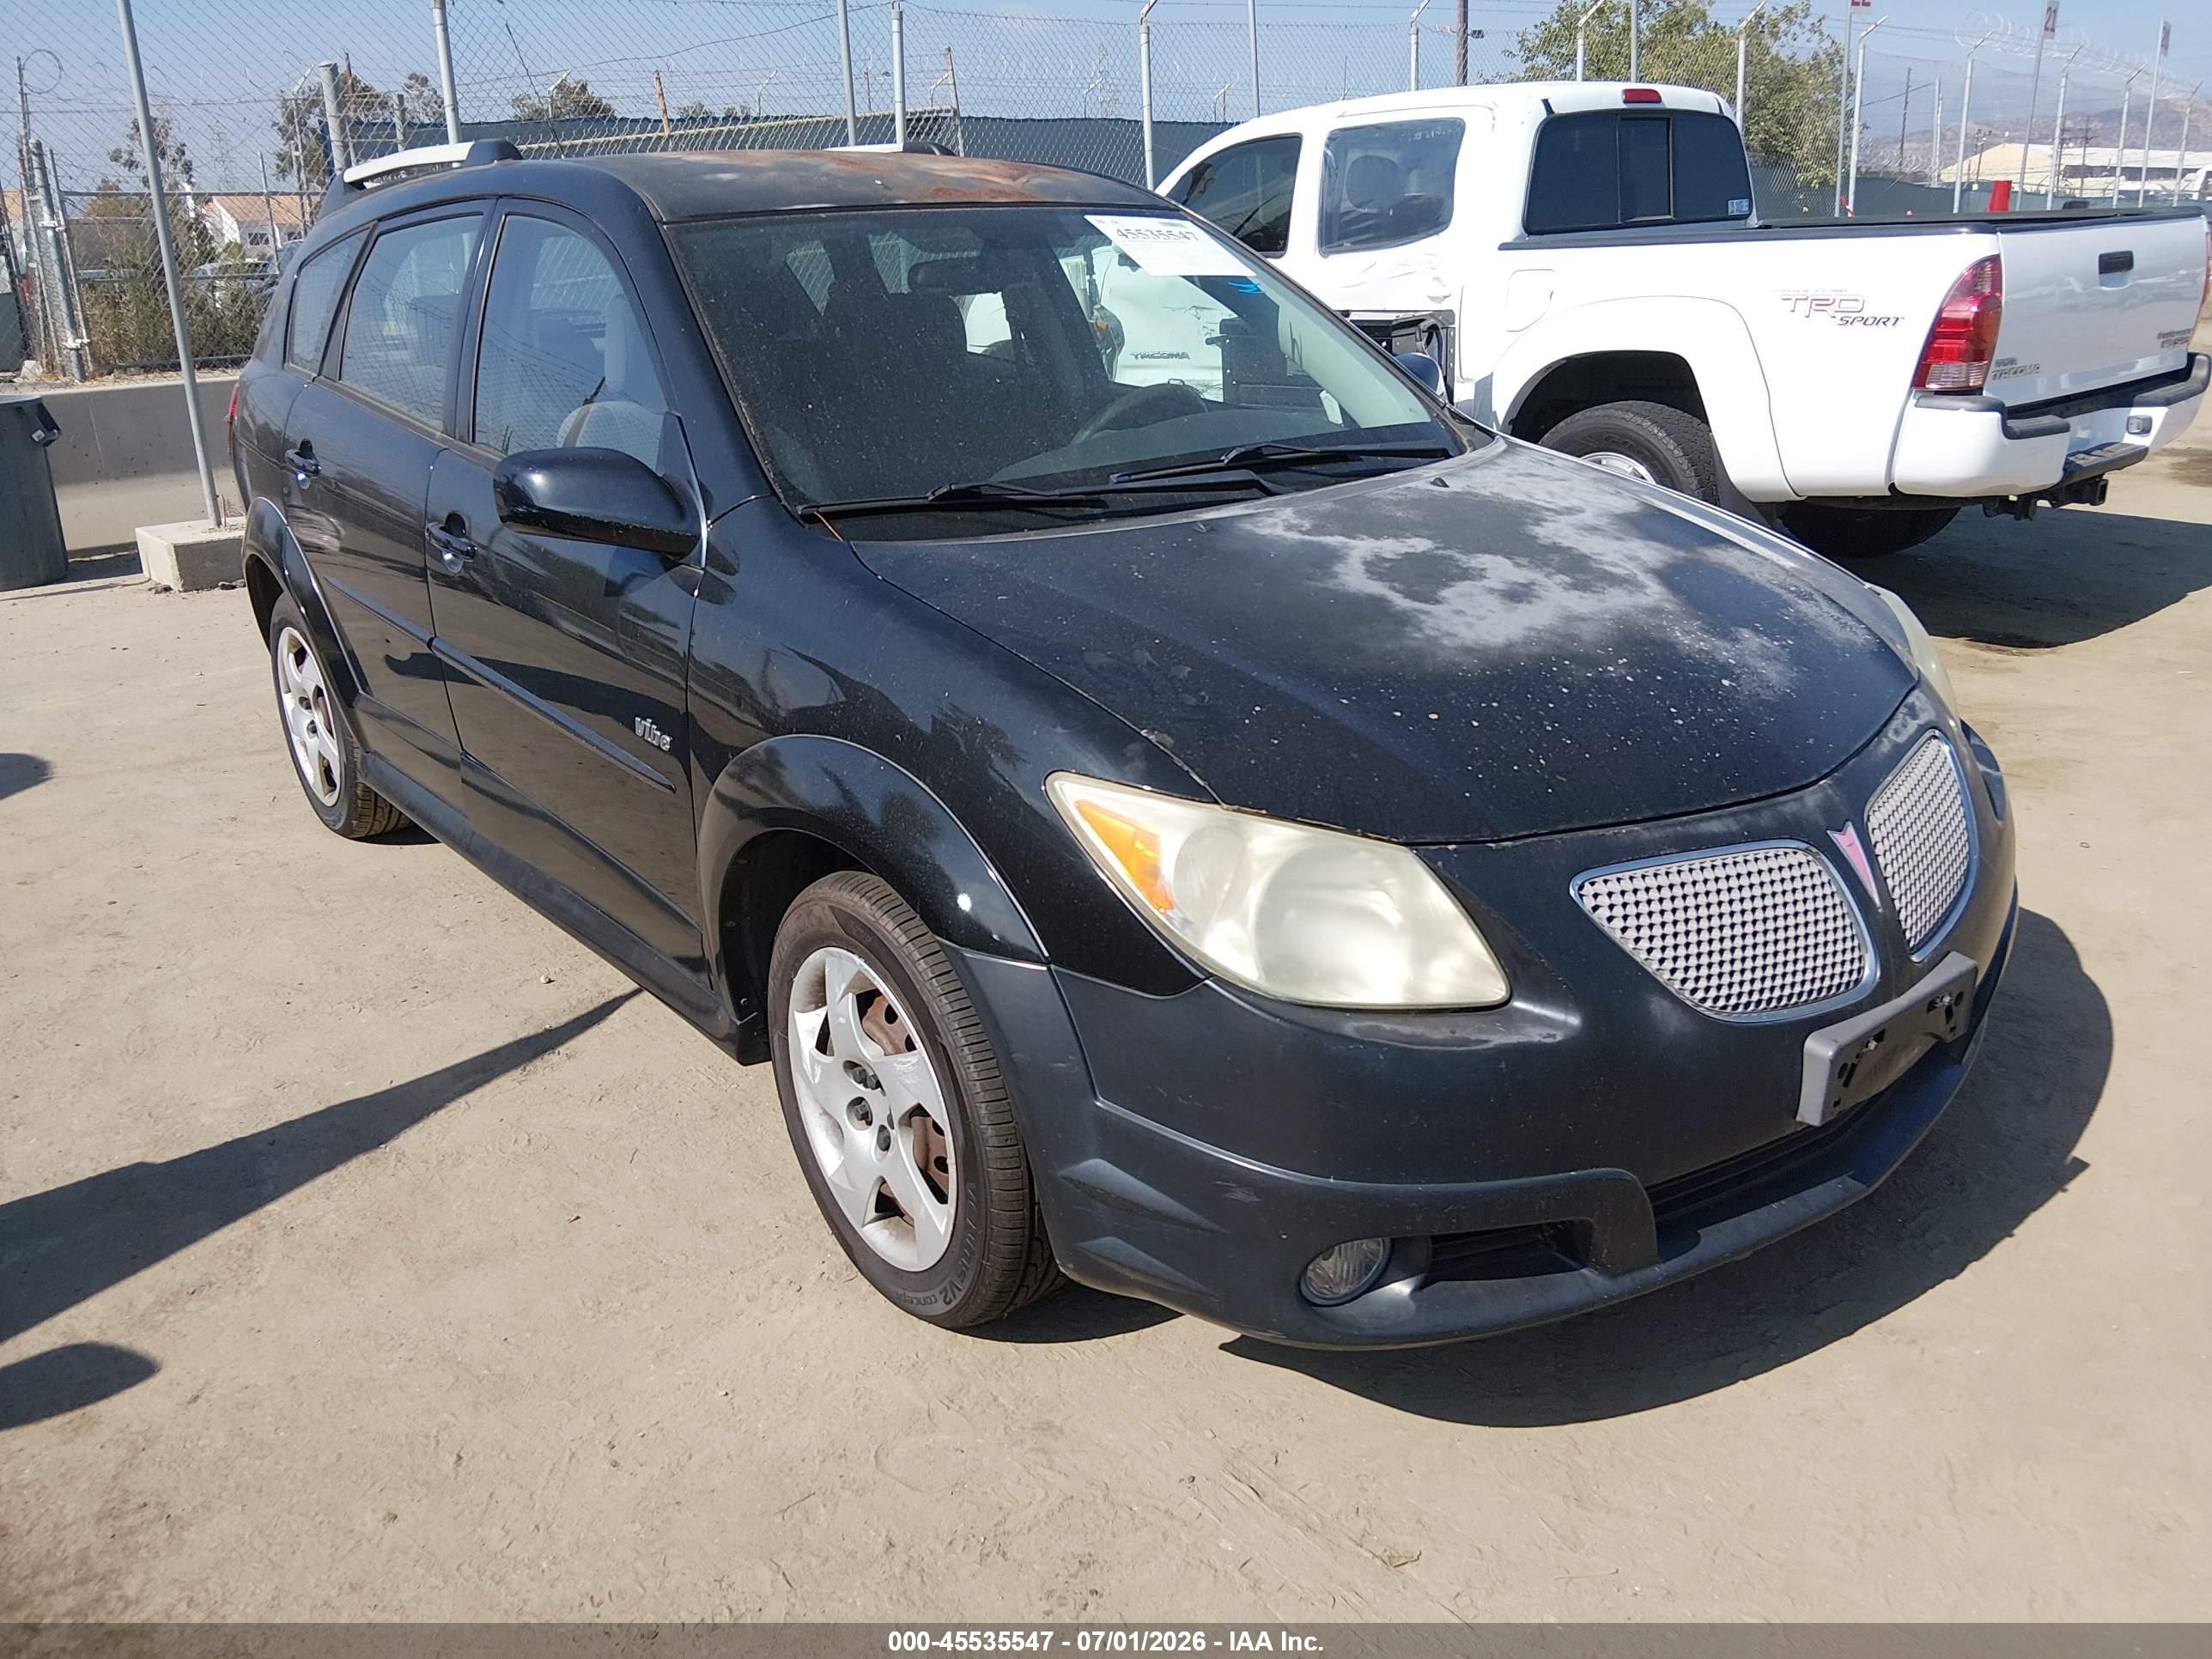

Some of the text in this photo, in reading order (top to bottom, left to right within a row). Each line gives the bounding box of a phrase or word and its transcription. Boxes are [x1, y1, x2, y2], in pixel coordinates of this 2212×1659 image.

[1115, 227, 1200, 241] 45535547
[1780, 294, 1865, 319] TRD
[1837, 315, 1902, 327] SPORT
[635, 716, 672, 752] Vibe
